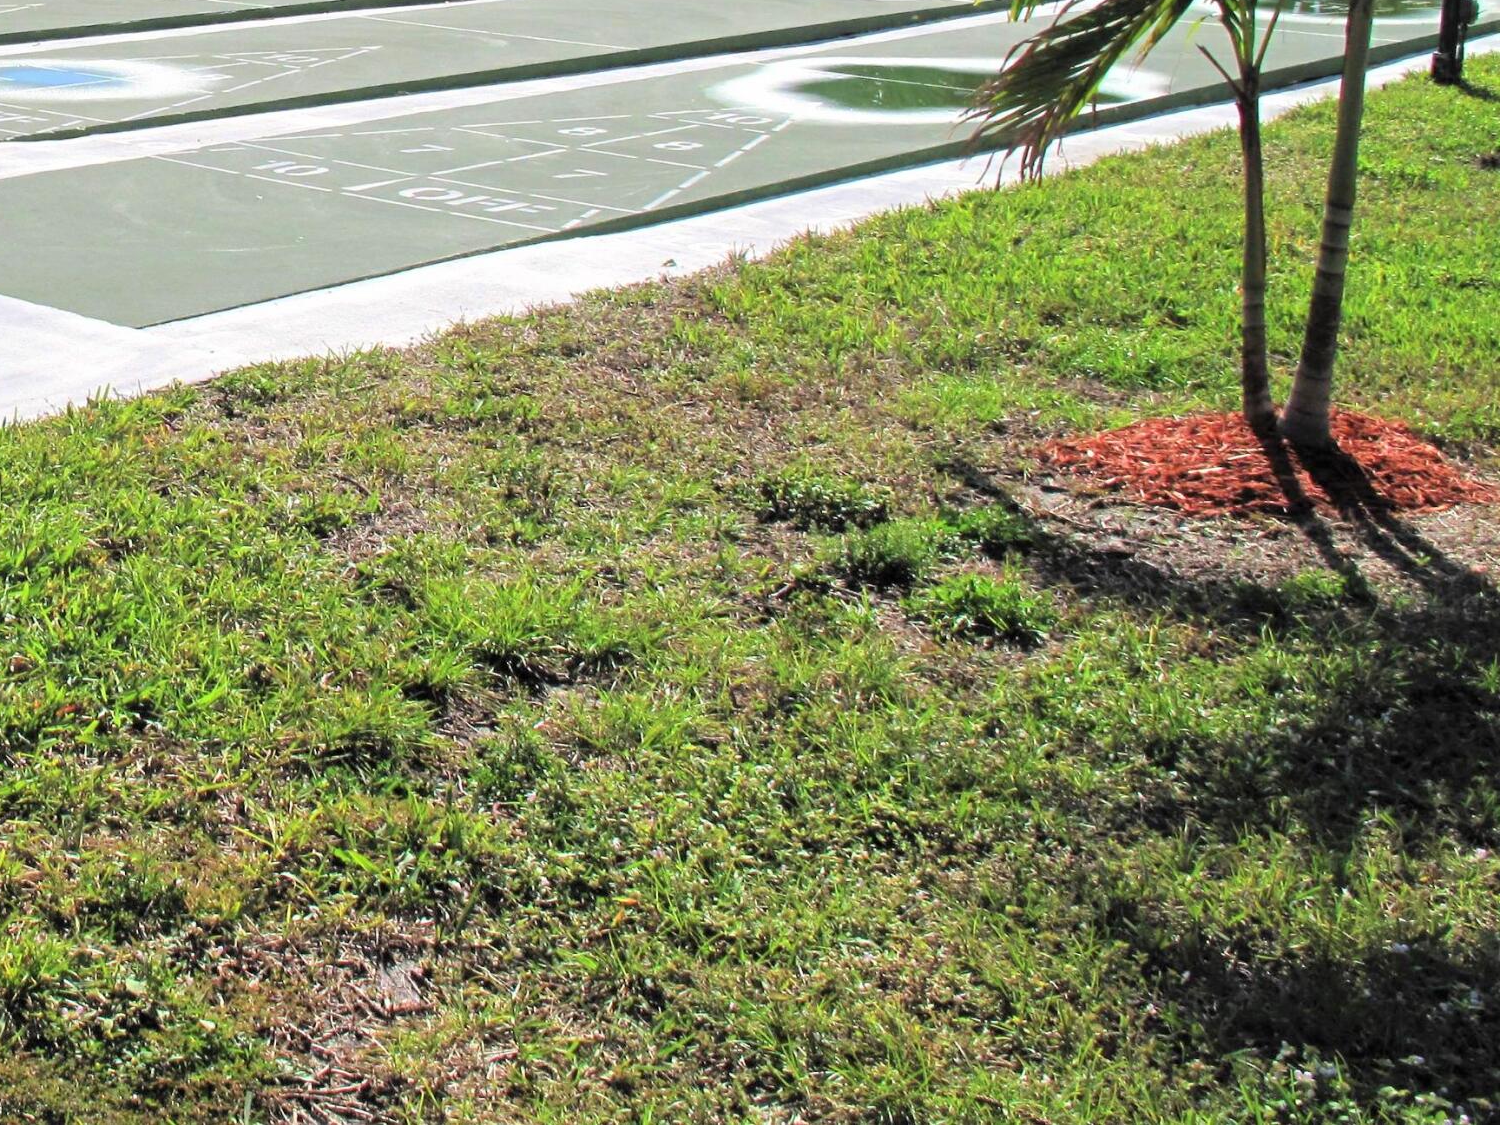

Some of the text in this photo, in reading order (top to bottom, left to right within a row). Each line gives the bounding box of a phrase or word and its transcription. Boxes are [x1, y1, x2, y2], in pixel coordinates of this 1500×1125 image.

[704, 112, 773, 125] 10
[557, 126, 609, 136] 8
[399, 144, 456, 153] 7
[652, 140, 704, 151] 8
[251, 160, 330, 176] 10
[552, 169, 609, 179] 7
[398, 187, 558, 214] OFF
